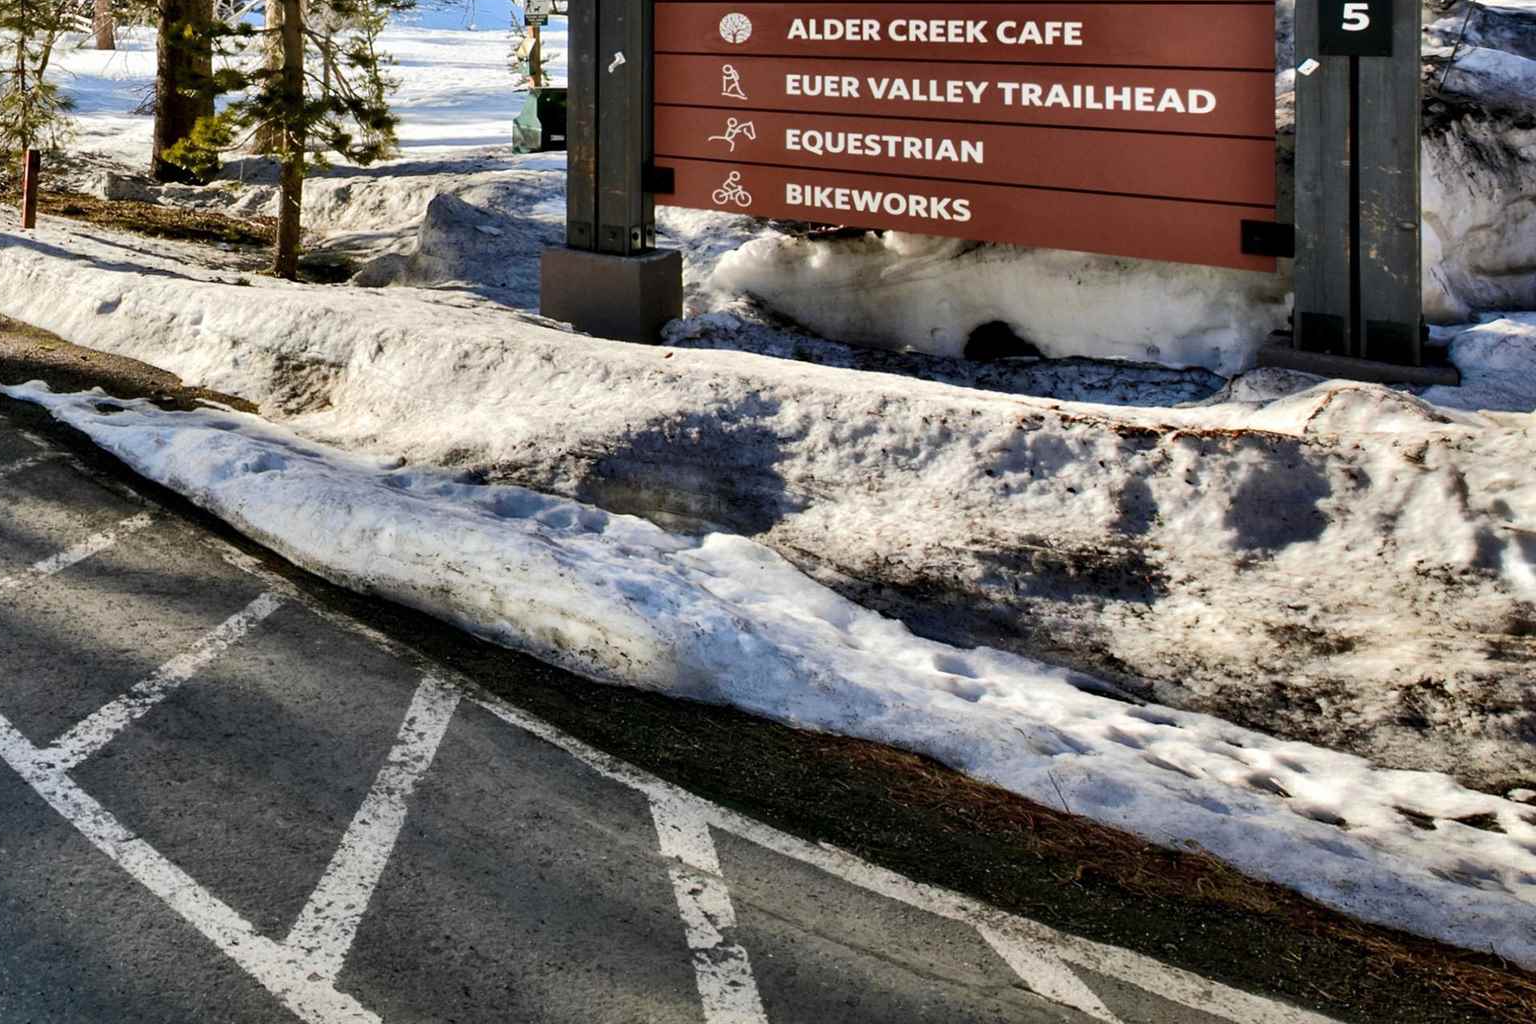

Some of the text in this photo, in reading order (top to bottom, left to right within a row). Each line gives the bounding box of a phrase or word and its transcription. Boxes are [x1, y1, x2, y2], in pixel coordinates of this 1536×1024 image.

[786, 18, 1084, 47] ALDER CREEK CAFE
[785, 73, 1218, 115] EUER VALLEY TRAILHEAD
[785, 128, 985, 165] EQUESTRIAN
[785, 182, 972, 223] BIKEWORKS
